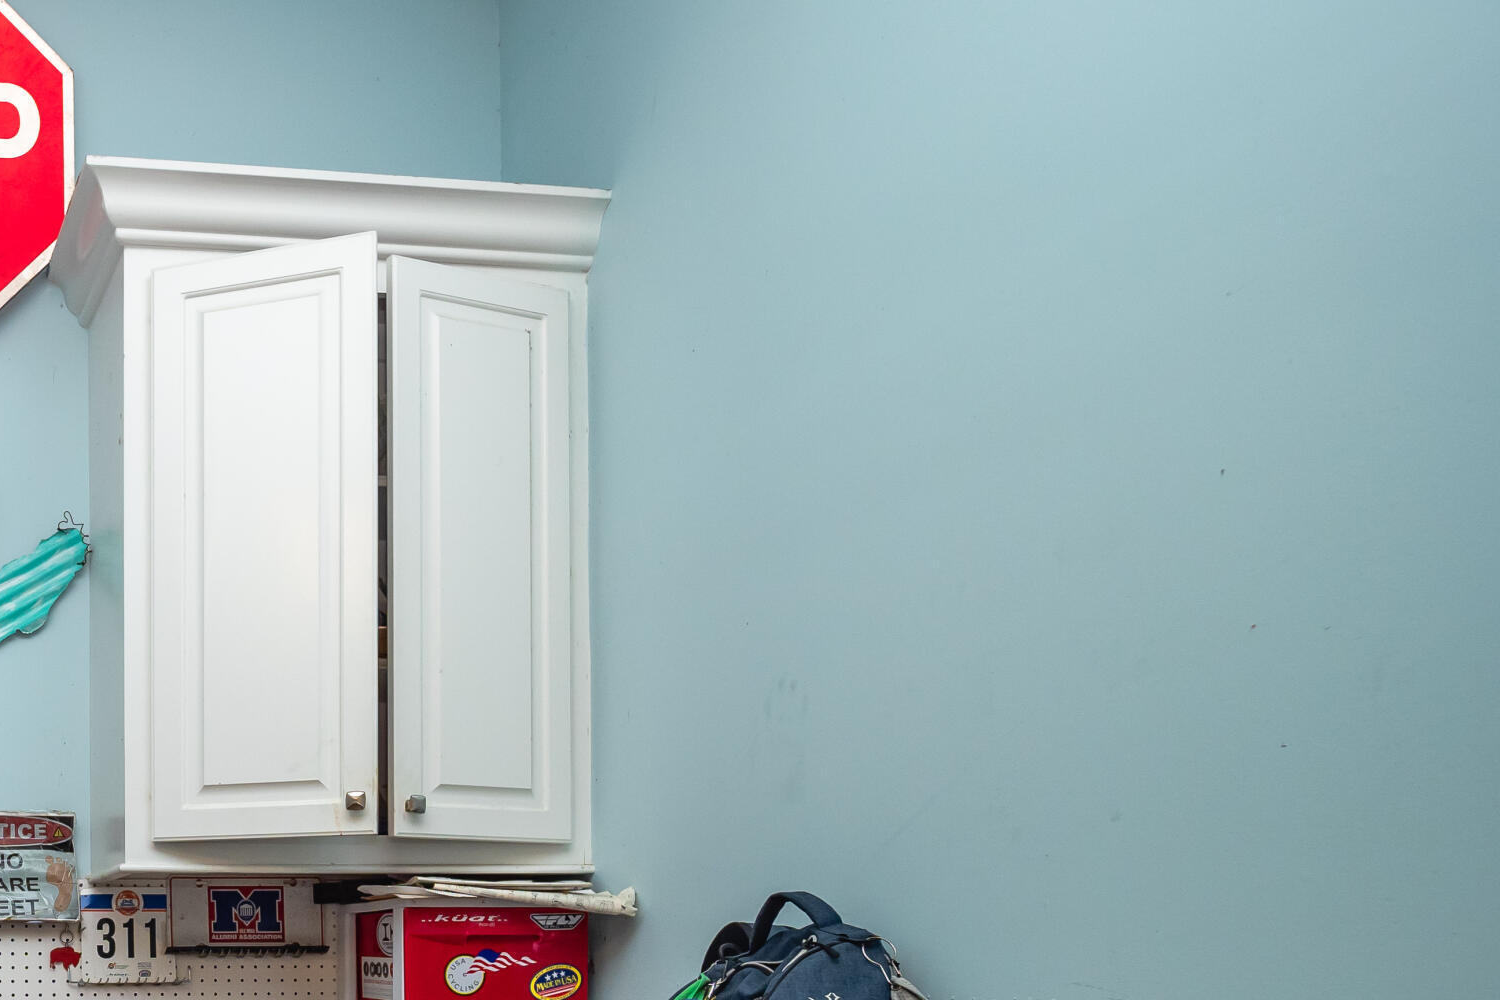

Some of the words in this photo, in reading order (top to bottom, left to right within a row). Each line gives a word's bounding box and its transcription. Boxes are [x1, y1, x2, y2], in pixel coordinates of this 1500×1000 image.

[96, 917, 157, 959] 311
[451, 958, 467, 972] USA
[447, 973, 481, 993] CYCLING
